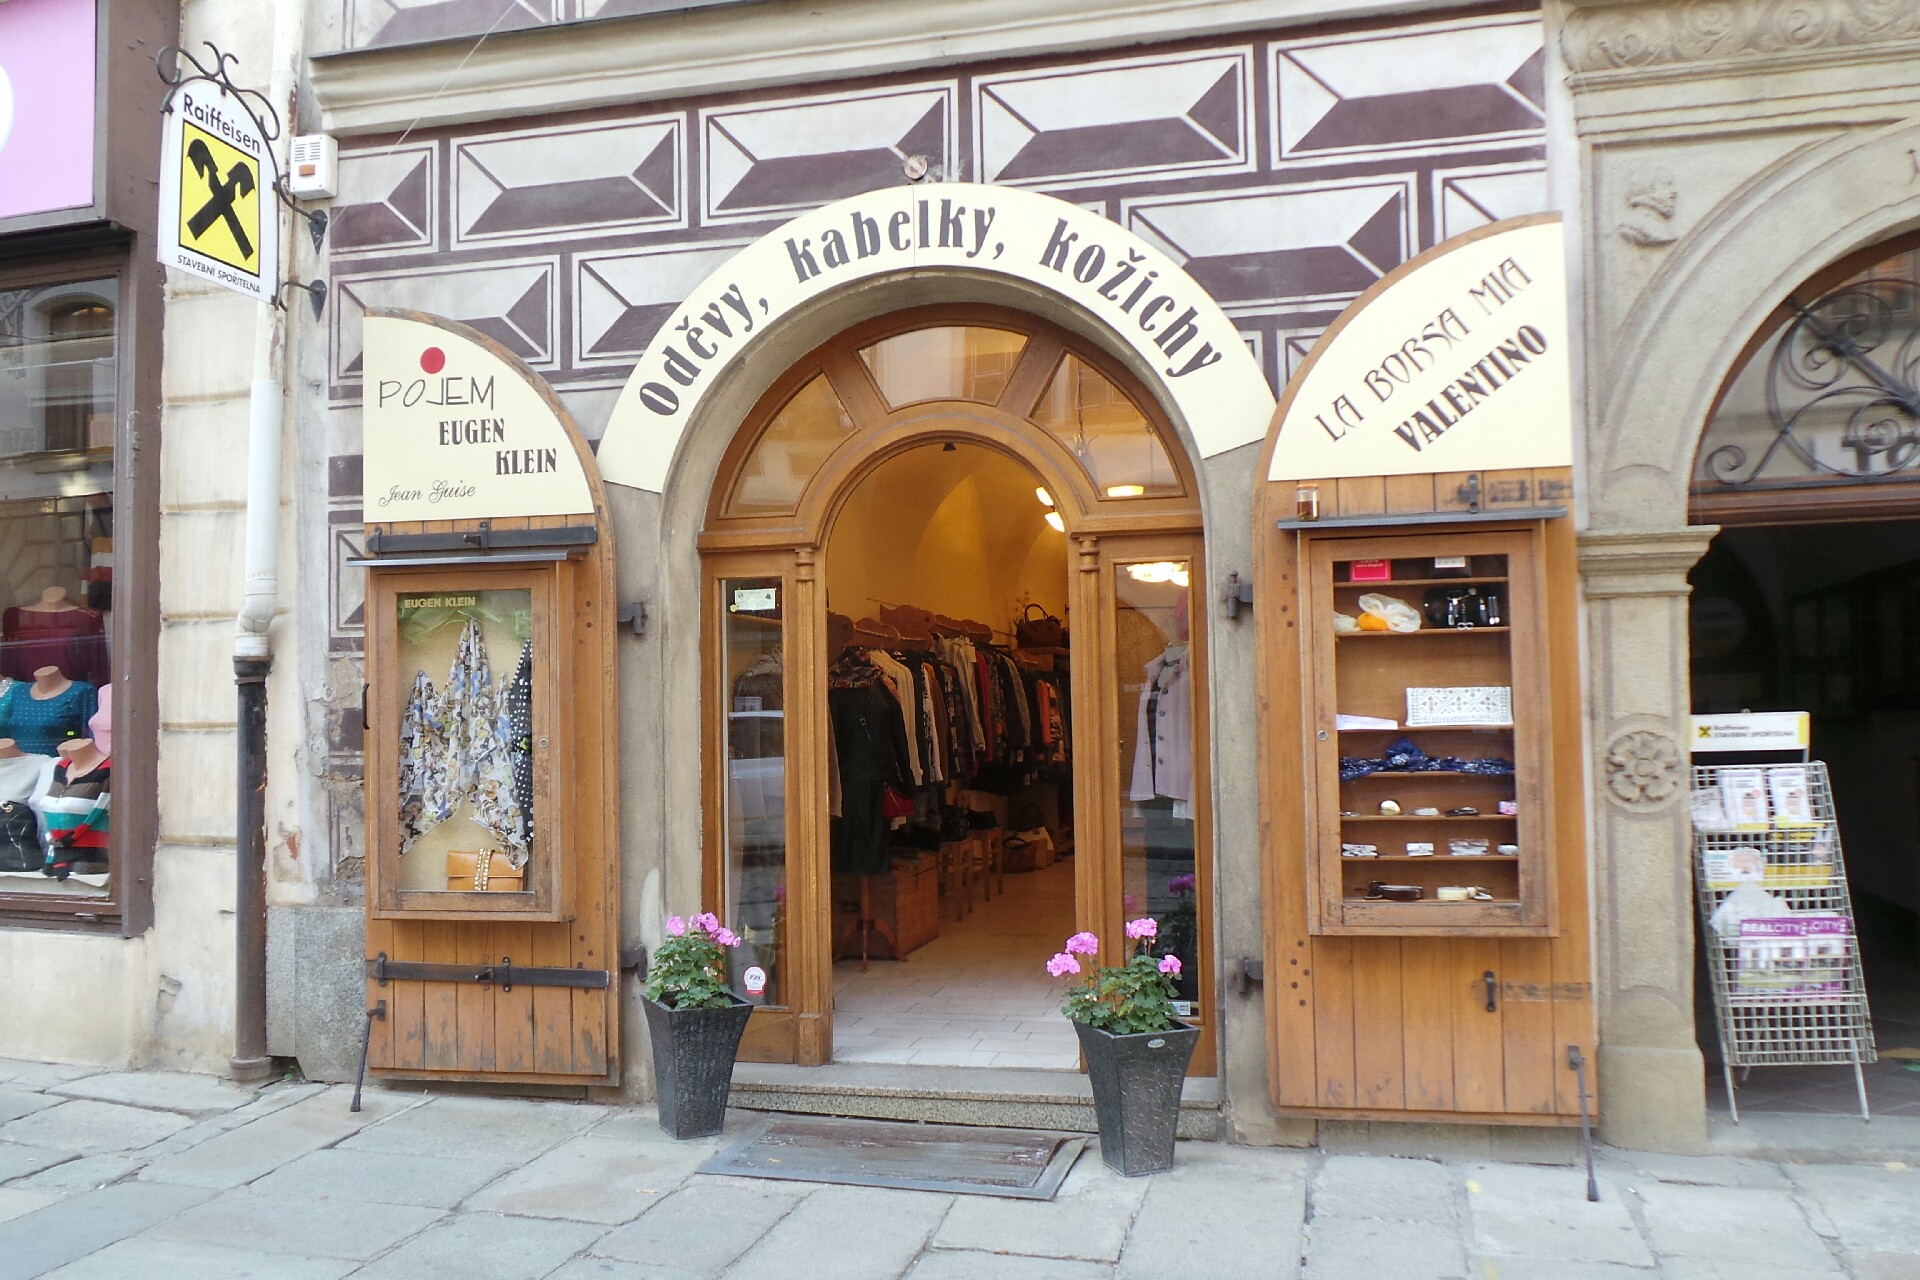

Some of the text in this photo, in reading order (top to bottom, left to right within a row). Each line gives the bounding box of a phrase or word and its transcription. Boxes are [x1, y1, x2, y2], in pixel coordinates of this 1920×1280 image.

[182, 92, 261, 154] Raiffeisen
[177, 254, 261, 294] STAVEBNÍ SPOŘITELNA
[639, 198, 1222, 416] Oděvy, kabelky, kožichy
[1313, 256, 1533, 442] LA BORSA MIA
[379, 375, 495, 411] POJEM
[1393, 324, 1549, 452] VALENTINO
[438, 418, 506, 447] EUGEN
[495, 448, 557, 476] KLEIN
[378, 479, 477, 508] Jean Guise
[404, 596, 476, 609] EUGEN KLEIN
[1742, 922, 1802, 934] REALCITY
